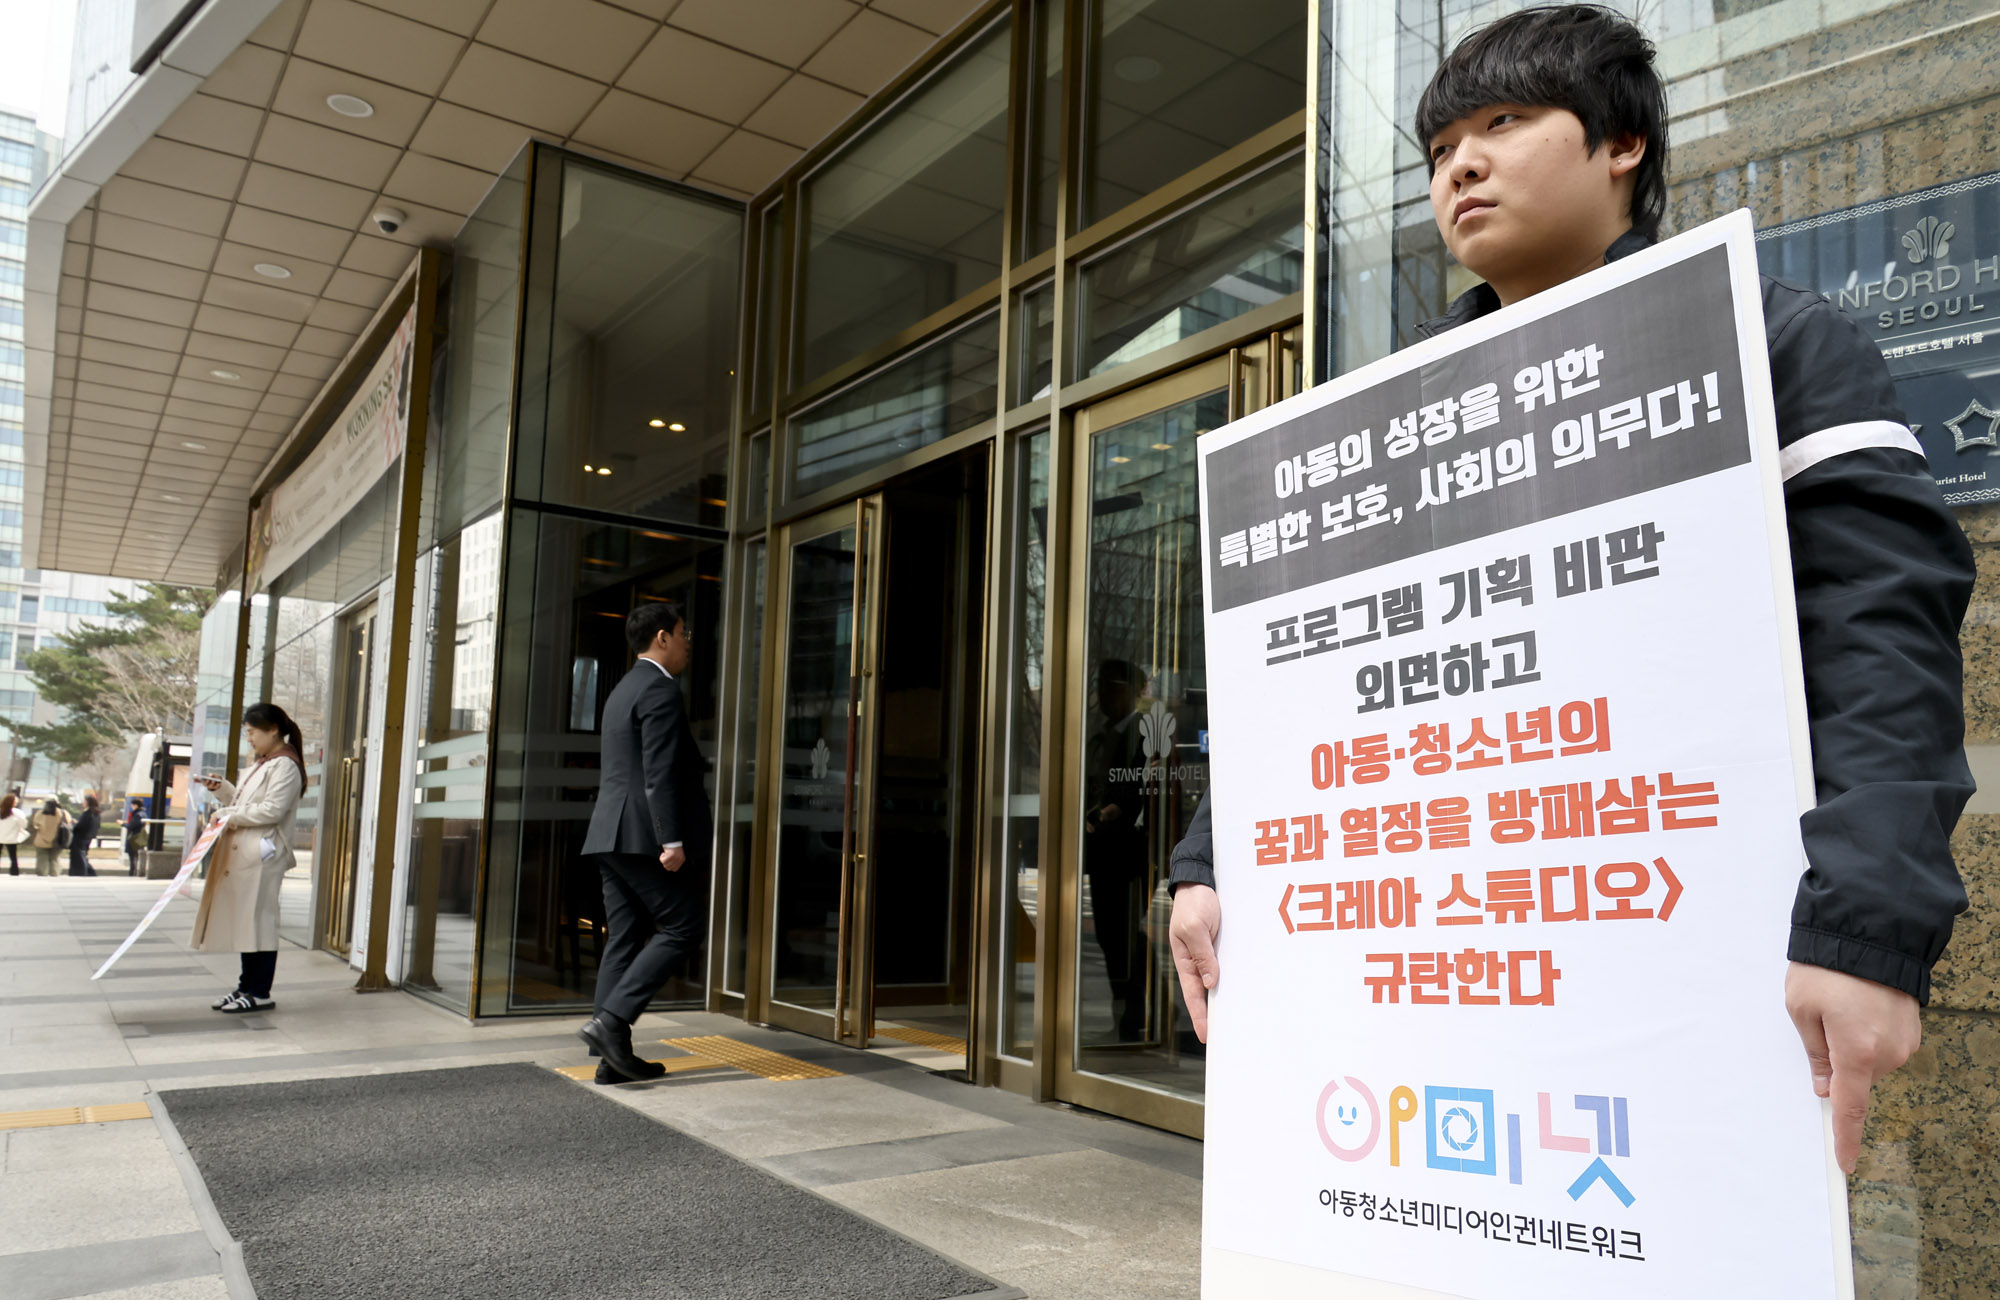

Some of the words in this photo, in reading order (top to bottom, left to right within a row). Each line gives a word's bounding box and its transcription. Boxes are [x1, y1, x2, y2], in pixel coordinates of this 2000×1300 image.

[1878, 294, 1984, 329] SEOUL
[1882, 337, 1954, 360] 스탠포드호텔
[1957, 332, 1984, 346] 서울
[1274, 427, 1373, 499] 아동의
[1383, 382, 1501, 460] 성장을
[1513, 343, 1604, 413] 위한
[1219, 509, 1311, 567] 특별한
[1320, 483, 1404, 540] 보호,
[1415, 439, 1536, 508] 사회의
[1552, 371, 1721, 469] 의무다!
[1959, 472, 1986, 483] Hotel
[1266, 580, 1424, 666] 프로그램
[1439, 553, 1533, 625] 기획
[1554, 521, 1665, 597] 비판
[1356, 630, 1541, 714] 외면하고
[1109, 766, 1165, 783] STANFORD
[1169, 765, 1207, 781] HOTEL
[1311, 696, 1611, 791] 아동·청소년의
[1254, 813, 1329, 866] 꿈과
[1340, 796, 1472, 858] 열정을
[1488, 772, 1720, 844] 방패삼는
[1364, 947, 1561, 1006] 규탄한다
[1319, 1188, 1646, 1262] 아동청소년미디어인권네트워크
